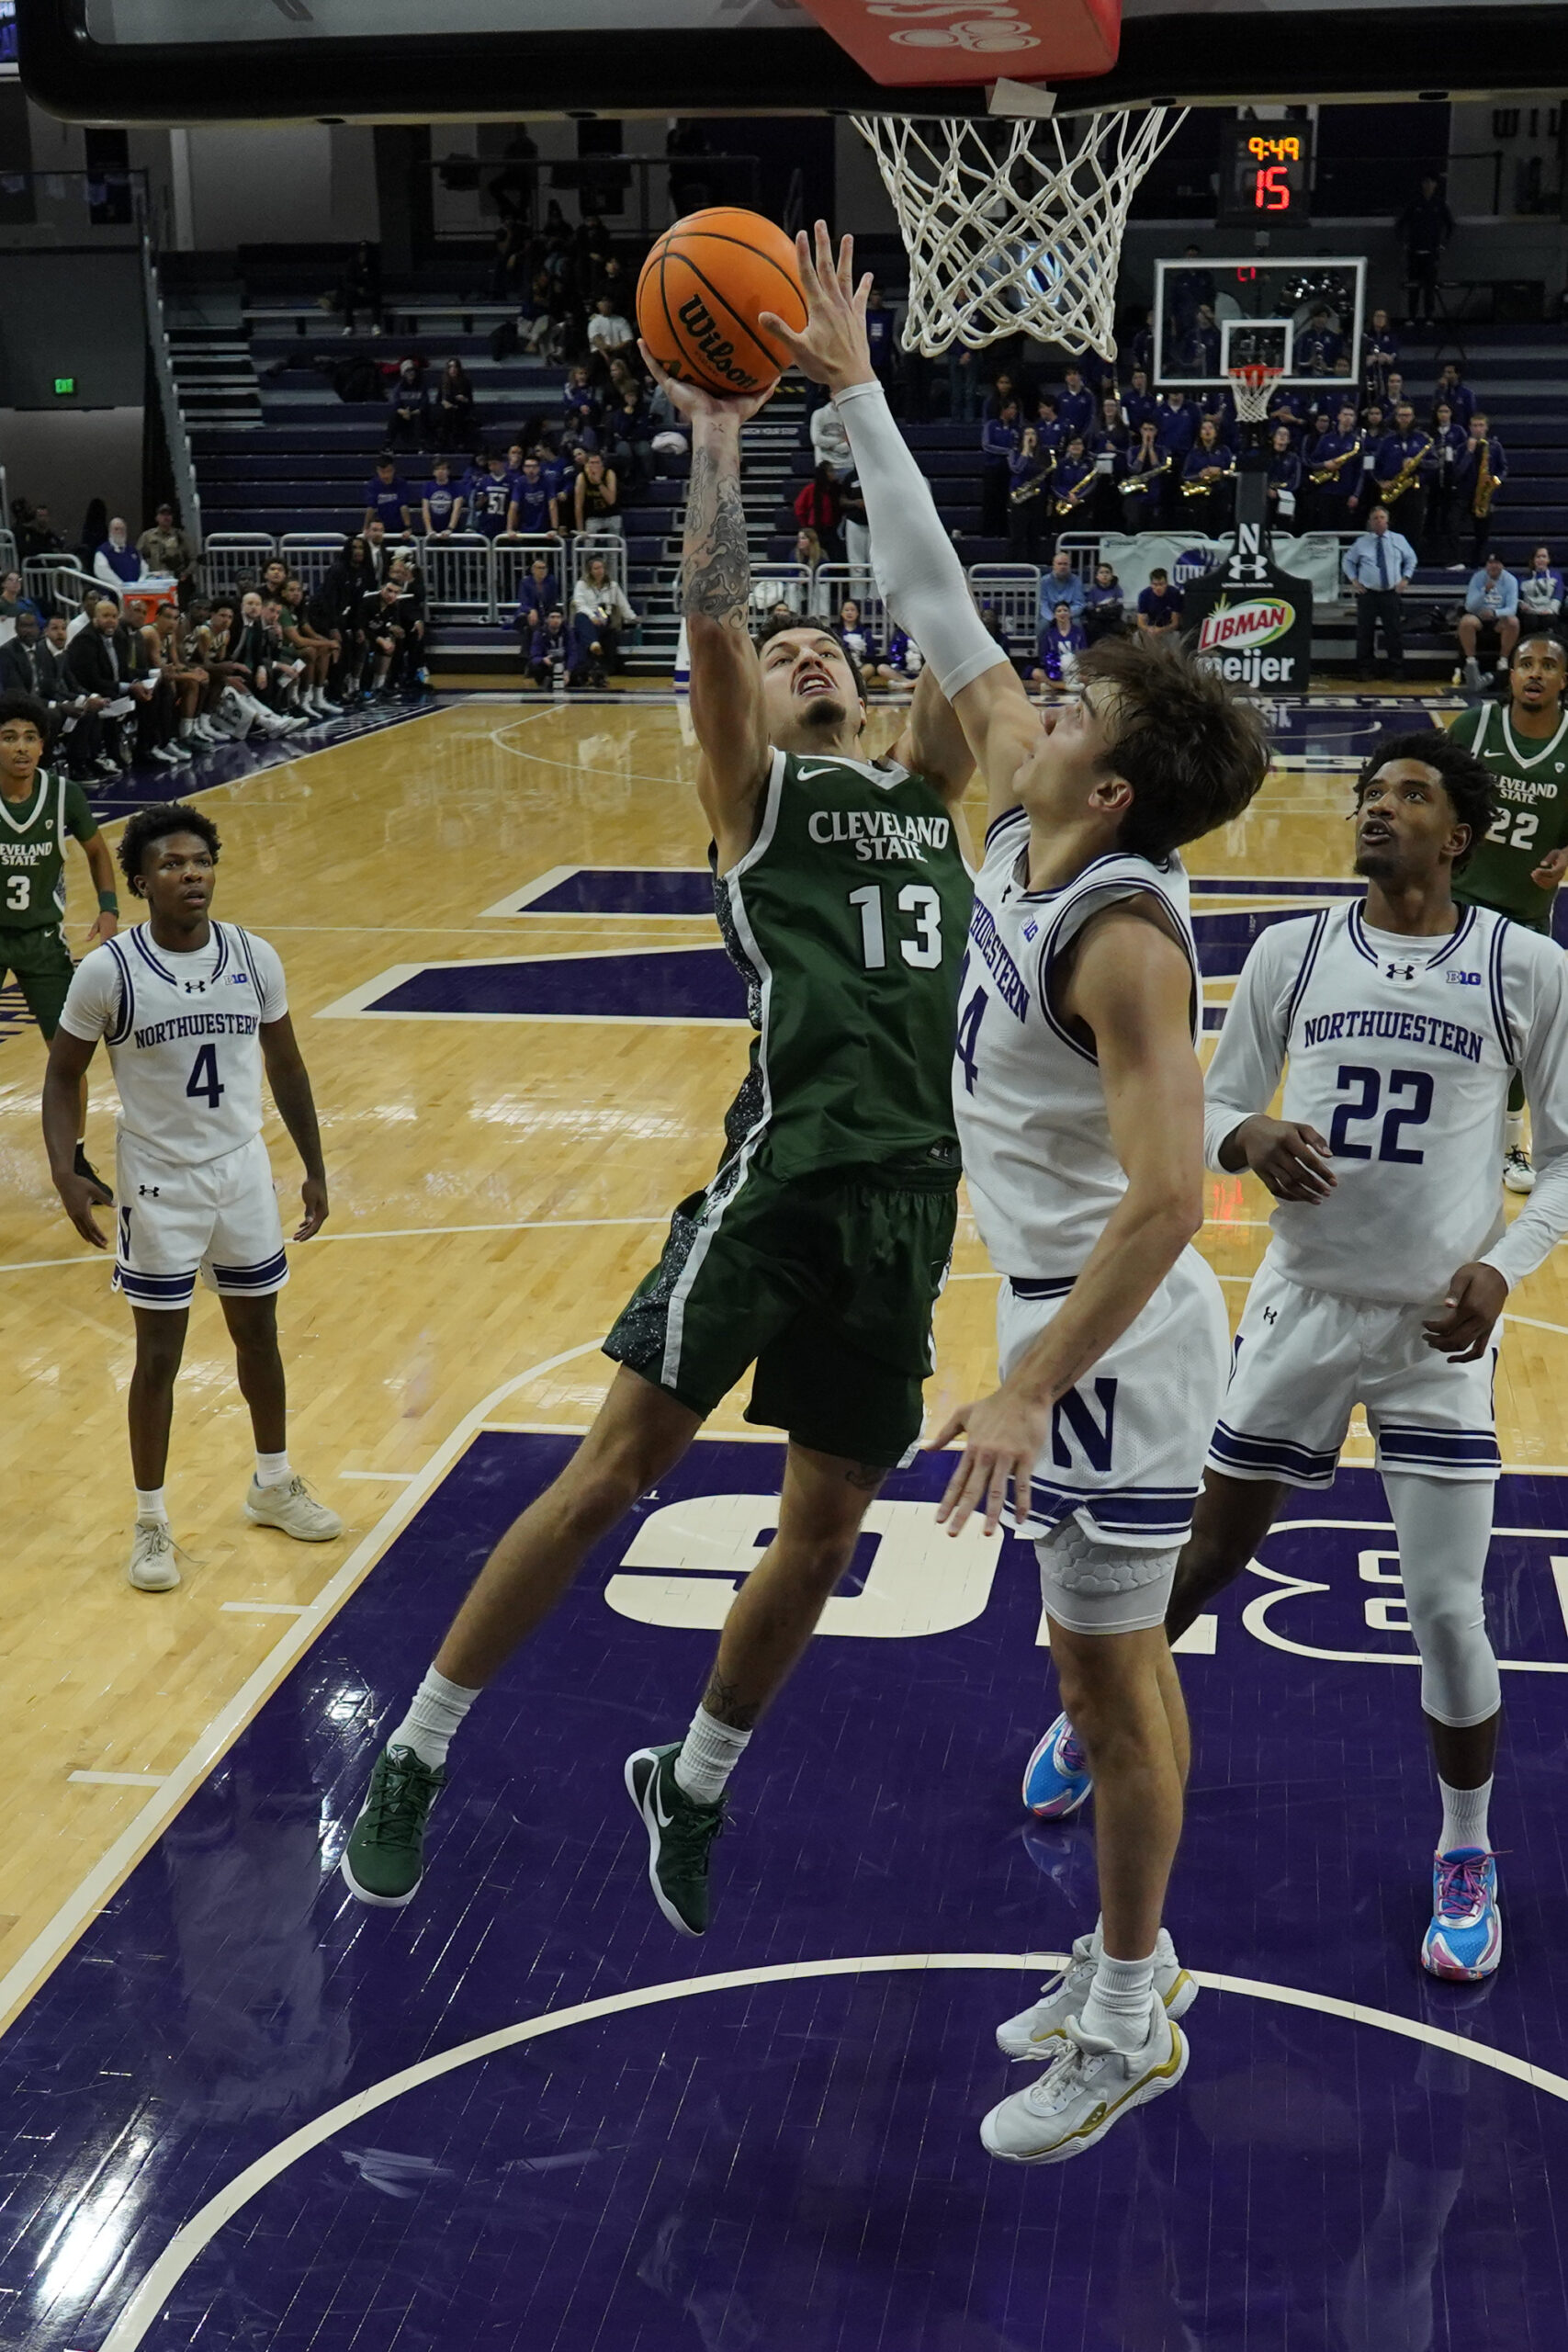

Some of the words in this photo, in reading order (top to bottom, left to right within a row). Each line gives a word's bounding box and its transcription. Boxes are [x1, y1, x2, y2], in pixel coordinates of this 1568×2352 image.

[1248, 137, 1300, 161] 9:49
[1255, 166, 1291, 209] 15
[678, 292, 760, 390] Wilson
[1238, 523, 1260, 555] N
[1200, 606, 1286, 650] LIBMAN
[1499, 788, 1538, 805] STATE
[808, 811, 950, 850] CLEVELAND
[855, 836, 929, 864] STATE
[1484, 807, 1540, 851] 22
[1, 854, 39, 866] STATE
[6, 875, 30, 910] 3
[849, 884, 943, 970] 13
[134, 1013, 258, 1049] NORTHWESTERN
[1304, 1011, 1484, 1064] NORTHWESTERN
[186, 1043, 225, 1109] 4
[1329, 1065, 1435, 1165] 22
[1051, 1377, 1118, 1472] N
